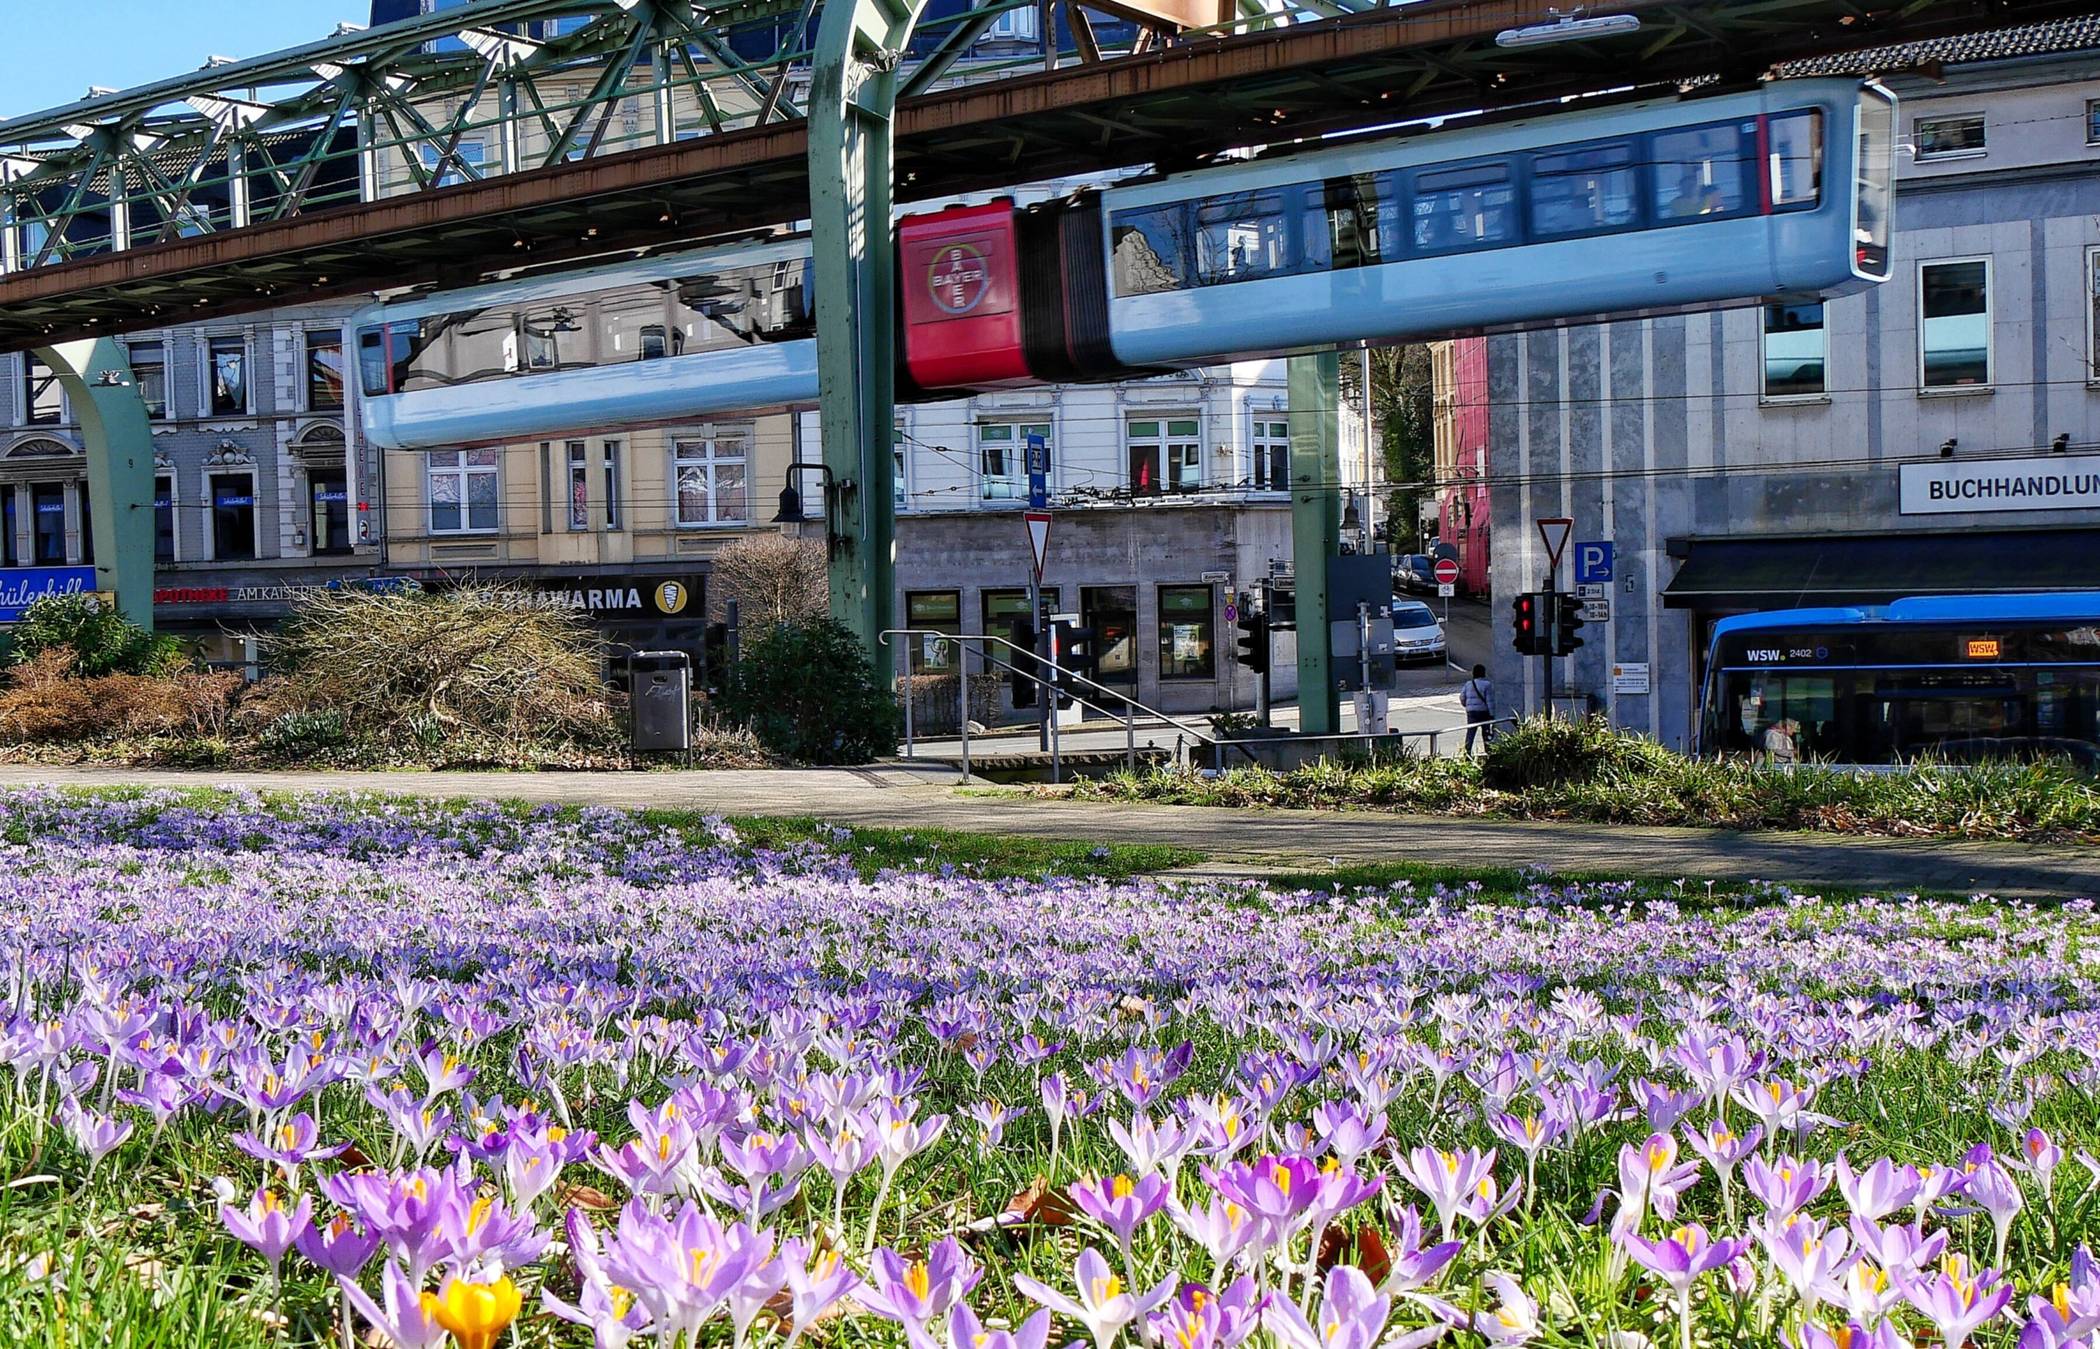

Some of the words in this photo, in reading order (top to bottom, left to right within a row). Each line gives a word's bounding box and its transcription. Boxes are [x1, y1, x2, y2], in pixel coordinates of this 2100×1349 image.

[933, 269, 983, 287] BAYER
[1583, 546, 1605, 578] P
[237, 587, 258, 600] AM
[1789, 648, 1812, 658] 2402
